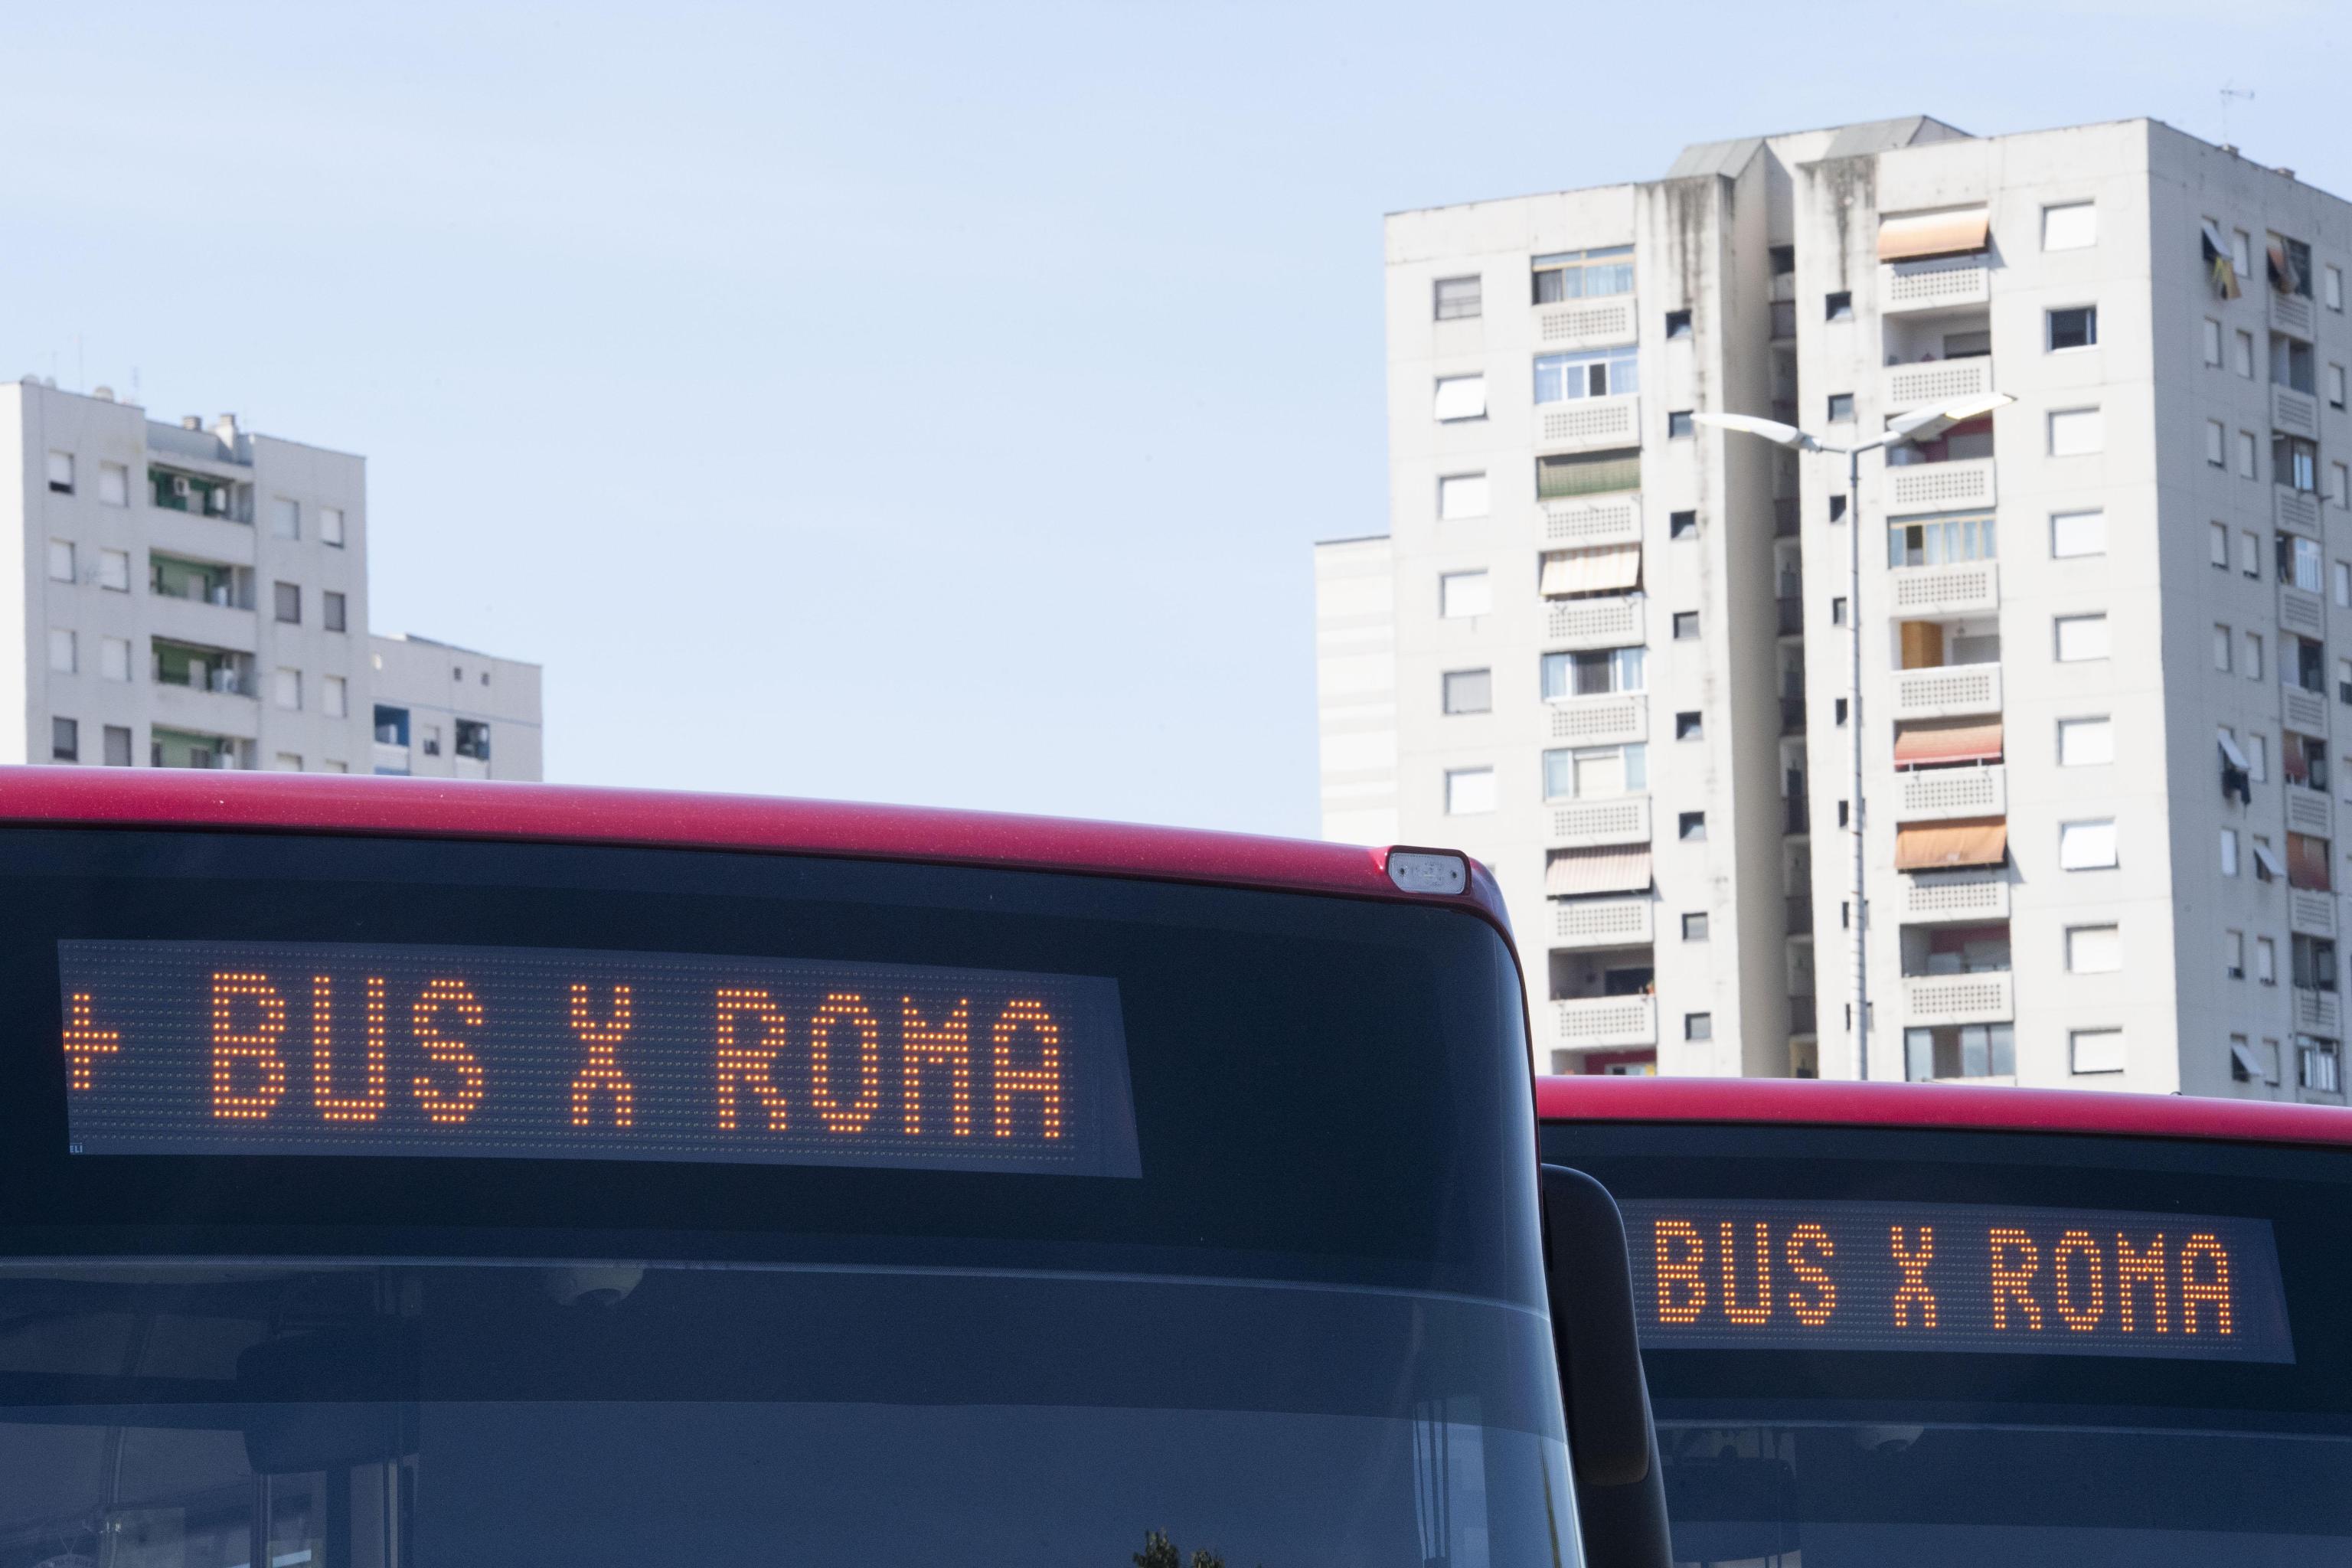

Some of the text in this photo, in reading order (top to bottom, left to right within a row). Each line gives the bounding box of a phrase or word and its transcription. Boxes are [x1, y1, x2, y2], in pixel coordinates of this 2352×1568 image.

[213, 972, 485, 1124] BUS
[571, 985, 634, 1128] X
[717, 989, 1062, 1140] ROMA
[1655, 1220, 2233, 1336] BUS X ROMA
